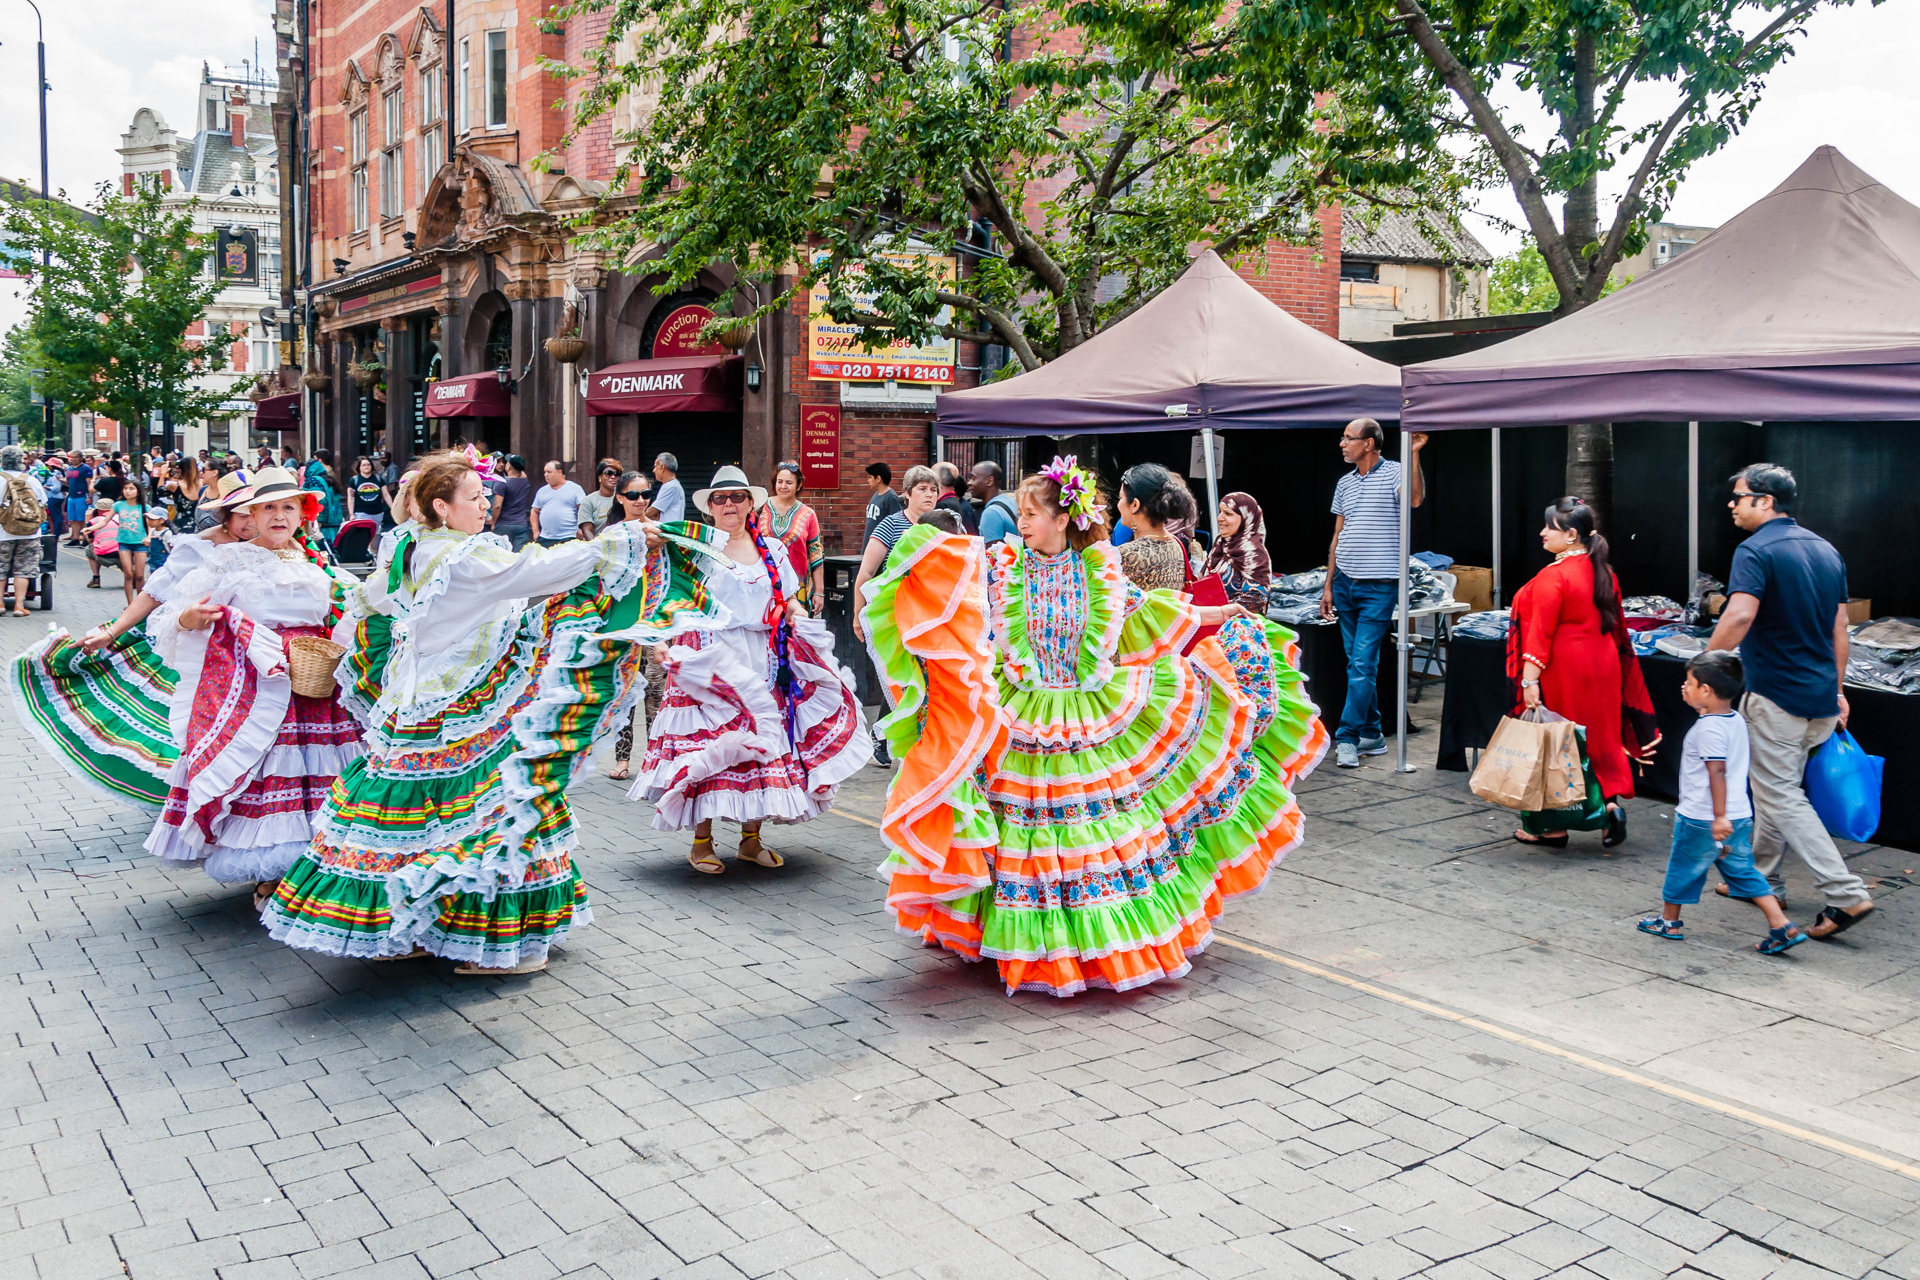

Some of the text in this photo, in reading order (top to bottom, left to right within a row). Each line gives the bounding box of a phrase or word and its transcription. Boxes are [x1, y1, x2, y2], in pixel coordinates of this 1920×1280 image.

[660, 313, 698, 346] function
[817, 325, 856, 334] MIRACLES
[842, 363, 950, 381] 020 7511 2140
[436, 383, 468, 400] DENMARK
[599, 373, 685, 394] The DENMARK
[806, 410, 836, 422] welcome to
